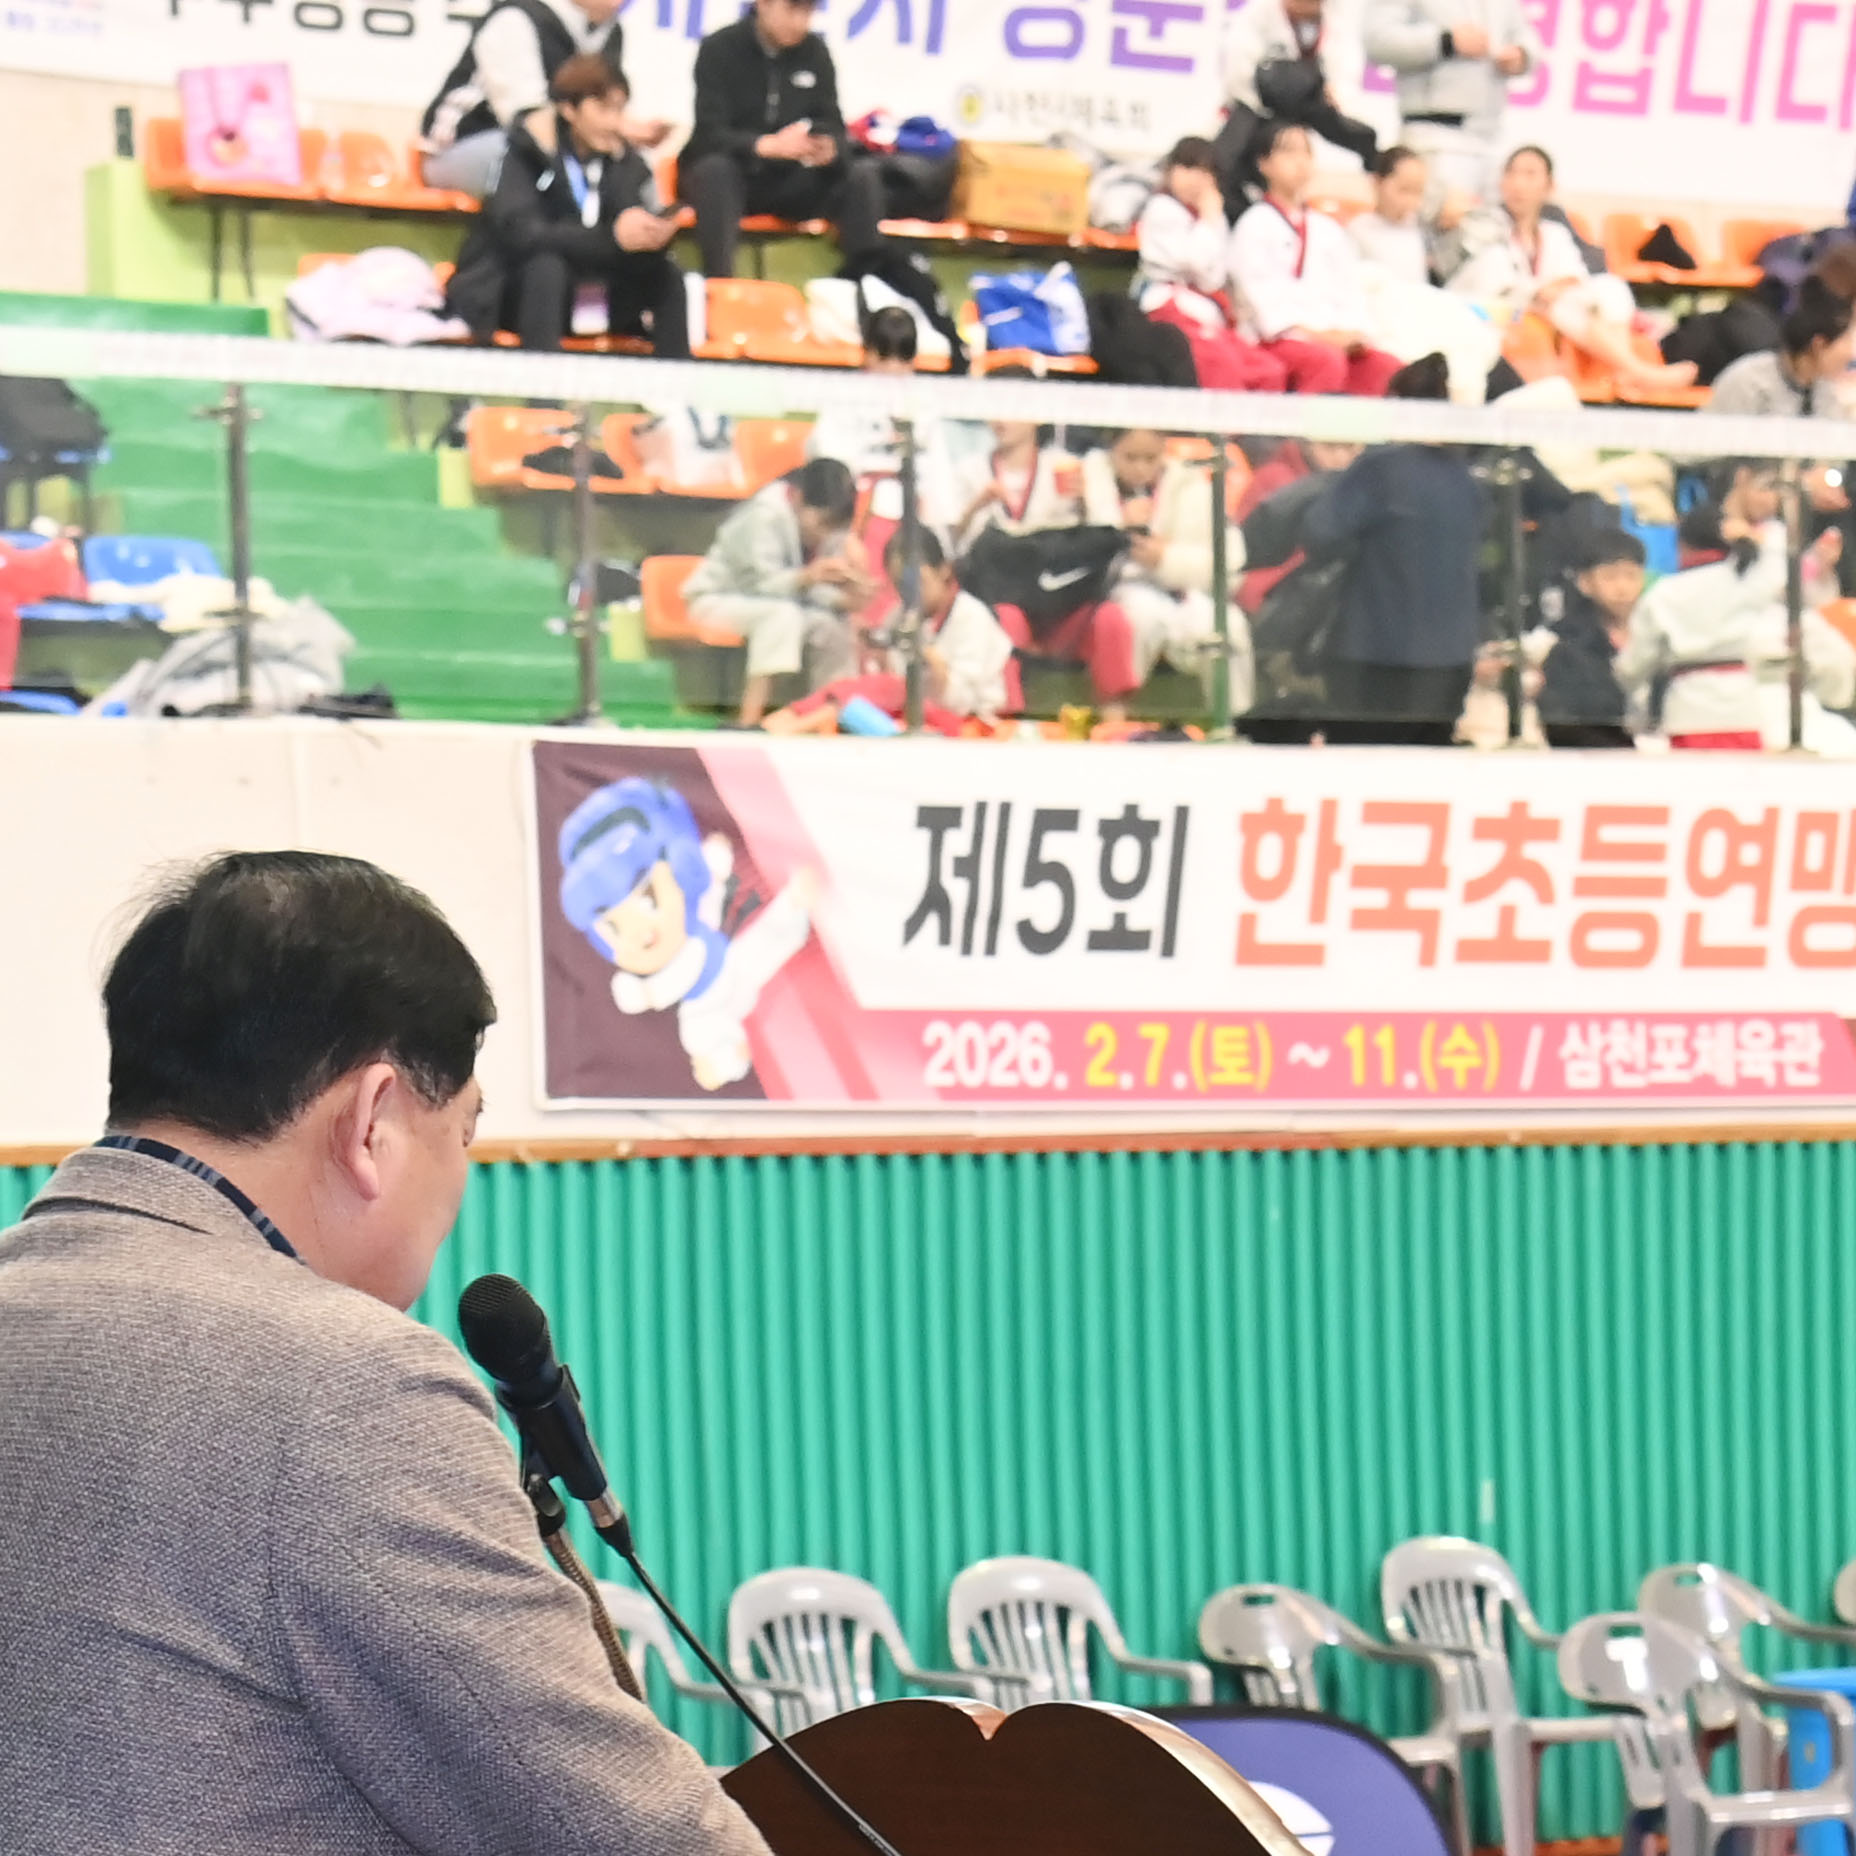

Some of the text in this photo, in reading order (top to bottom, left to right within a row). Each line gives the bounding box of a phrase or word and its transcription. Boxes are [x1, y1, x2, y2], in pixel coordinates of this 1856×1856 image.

[903, 801, 1190, 959] 제5회
[922, 1020, 1068, 1090] 2026.
[1558, 1018, 1824, 1090] 삼천포체육관
